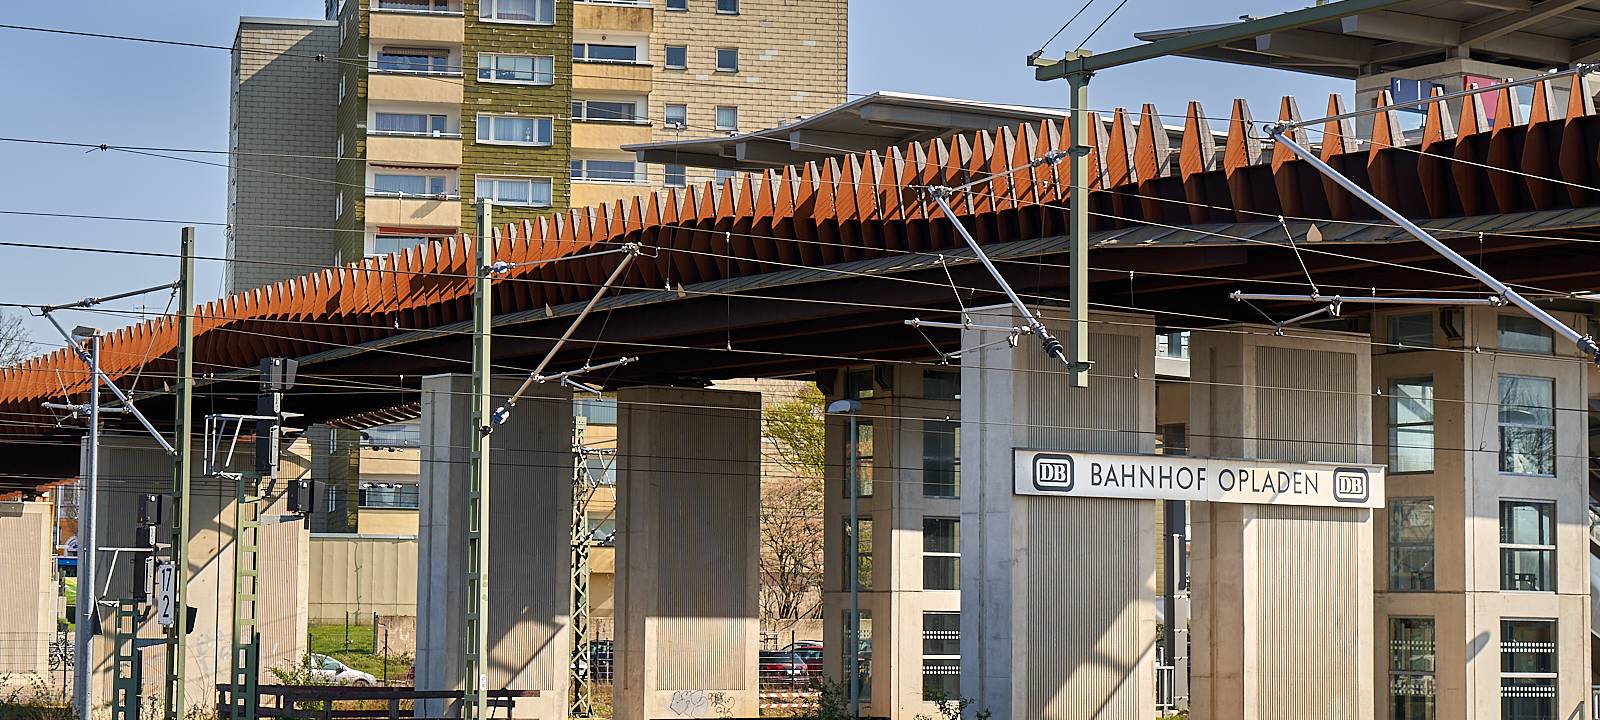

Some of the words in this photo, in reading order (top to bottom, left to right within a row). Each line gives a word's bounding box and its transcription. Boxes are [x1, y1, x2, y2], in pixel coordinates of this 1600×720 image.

[1039, 462, 1068, 483] DB
[1091, 462, 1207, 491] BAHNHOF
[1218, 468, 1319, 495] OPLADEN
[1338, 475, 1364, 495] DB
[161, 568, 172, 592] 17
[162, 594, 170, 618] 2
